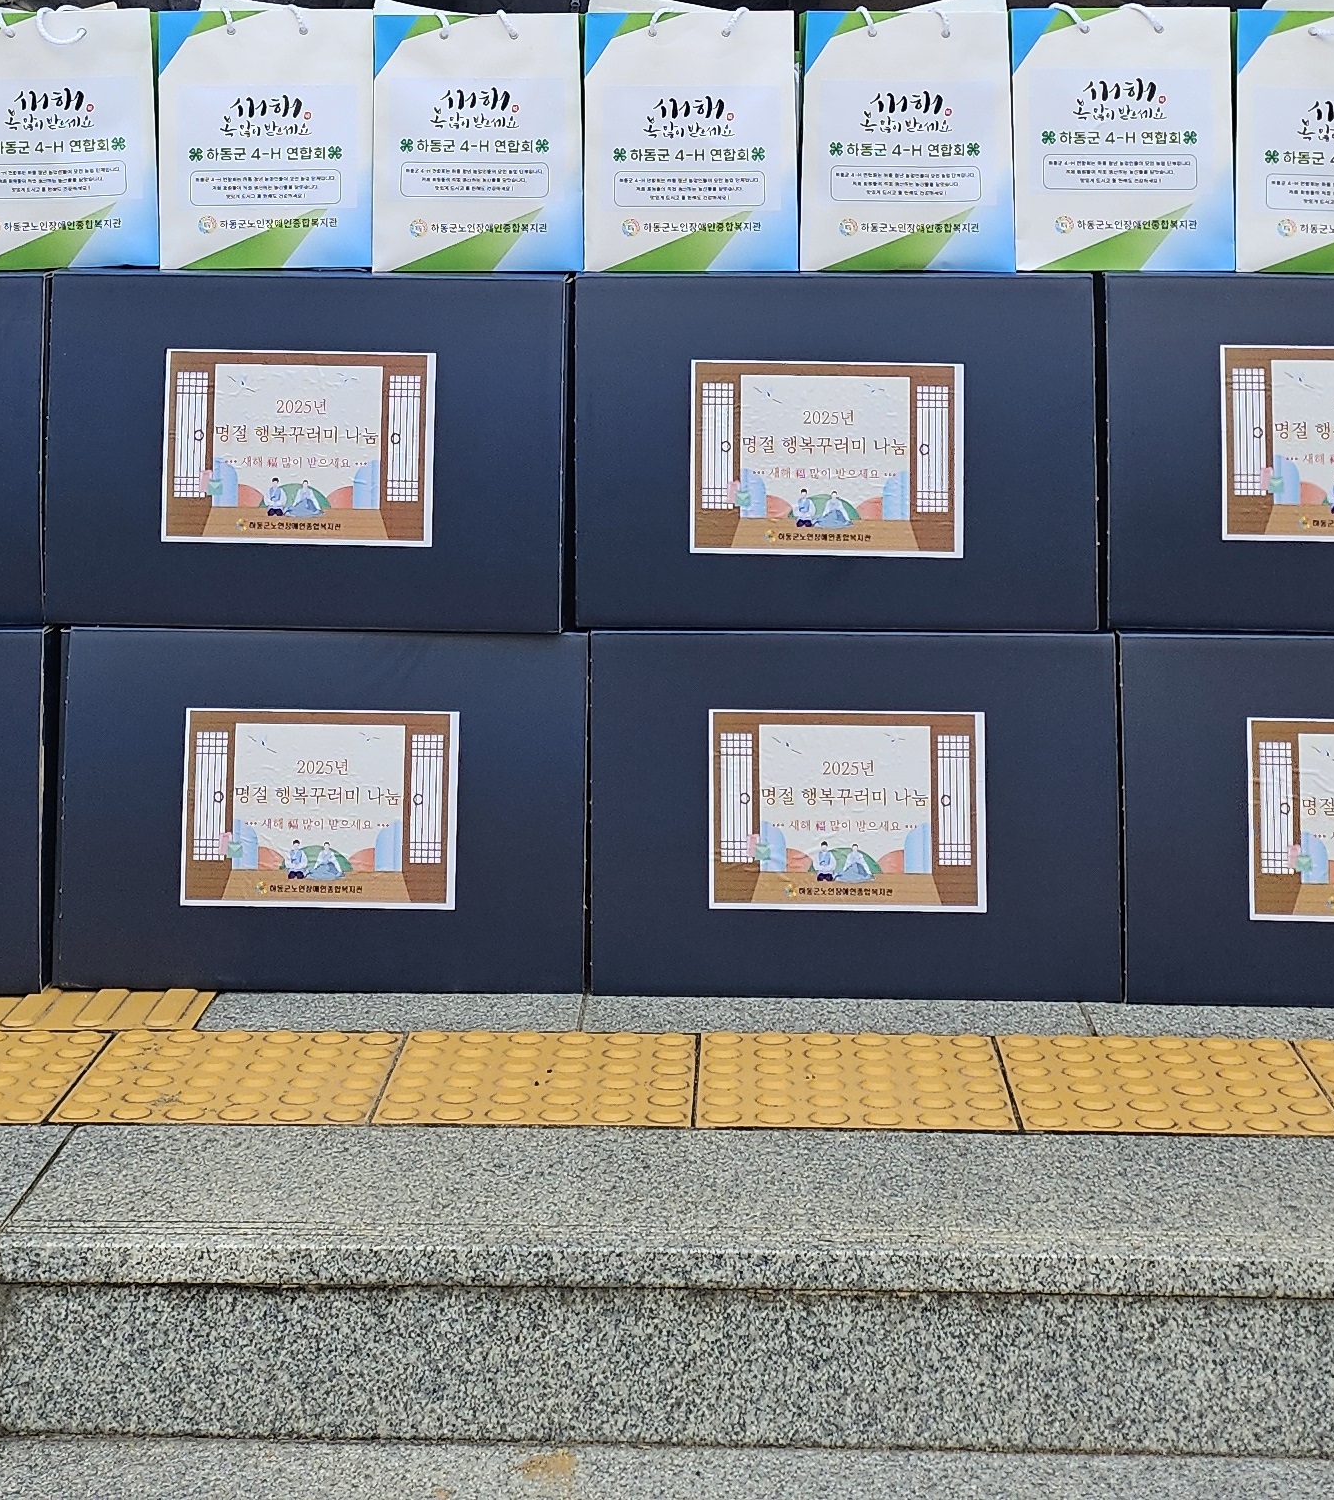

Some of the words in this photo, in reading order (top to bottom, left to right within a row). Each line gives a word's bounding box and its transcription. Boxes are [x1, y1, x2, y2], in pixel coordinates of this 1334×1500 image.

[1083, 78, 1156, 102] 새해
[13, 86, 84, 112] 새해
[230, 94, 302, 118] 새해
[440, 87, 510, 110] 새해
[870, 89, 943, 115] 새해
[653, 95, 725, 119] 새해
[3, 109, 21, 131] 복
[46, 112, 94, 129] 받으세요
[643, 116, 660, 138] 복
[687, 121, 735, 138] 받으세요
[1297, 117, 1316, 141] 복
[34, 140, 64, 153] 4-H
[69, 138, 110, 153] 연합회
[416, 139, 456, 152] 하동군
[460, 140, 489, 152] 4-H
[494, 139, 534, 153] 연합회
[1059, 131, 1100, 144] 하동군
[1105, 132, 1136, 144] 4-H
[1141, 131, 1182, 145] 연합회
[206, 147, 246, 161] 하동군
[251, 148, 281, 160] 4-H
[286, 146, 326, 160] 연합회
[630, 149, 670, 162] 하동군
[674, 149, 704, 161] 4-H
[710, 148, 749, 162] 연합회
[846, 143, 887, 156] 하동군
[891, 144, 922, 156] 4-H
[927, 143, 966, 157] 연합회
[1283, 151, 1325, 165] 하동군
[3, 219, 121, 232] 하동군노인장애인종합복지관
[219, 218, 338, 230] 하동군노인장애인종합복지관
[430, 223, 548, 234] 하동군노인장애인종합복지관
[643, 222, 762, 233] 하동군노인장애인종합복지관
[861, 222, 980, 235] 하동군노인장애인종합복지관
[1077, 219, 1198, 231] 하동군노인장애인종합복지관
[276, 398, 326, 414] 2025년
[803, 409, 854, 425] 2025년
[216, 424, 247, 442] 명절
[254, 425, 337, 444] 행복꾸러미
[346, 427, 378, 444] 나눔
[1274, 421, 1307, 439] 명절
[742, 436, 774, 453] 명절
[782, 436, 866, 455] 행복꾸러미
[874, 438, 907, 455] 나눔
[241, 456, 262, 468] 새해
[282, 457, 302, 468] 많이
[308, 457, 350, 469] 받으세요
[297, 758, 348, 775] 2025년
[822, 760, 874, 776] 2025년
[236, 785, 267, 803] 명절
[275, 786, 359, 805] 행복꾸러미
[368, 787, 400, 805] 나눔
[761, 787, 794, 805] 명절
[801, 787, 887, 806] 행복꾸러미
[895, 789, 928, 807] 나눔
[1302, 797, 1334, 816] 명절
[261, 818, 283, 829] 새해
[302, 818, 324, 830] 많이
[329, 819, 372, 831] 받으세요
